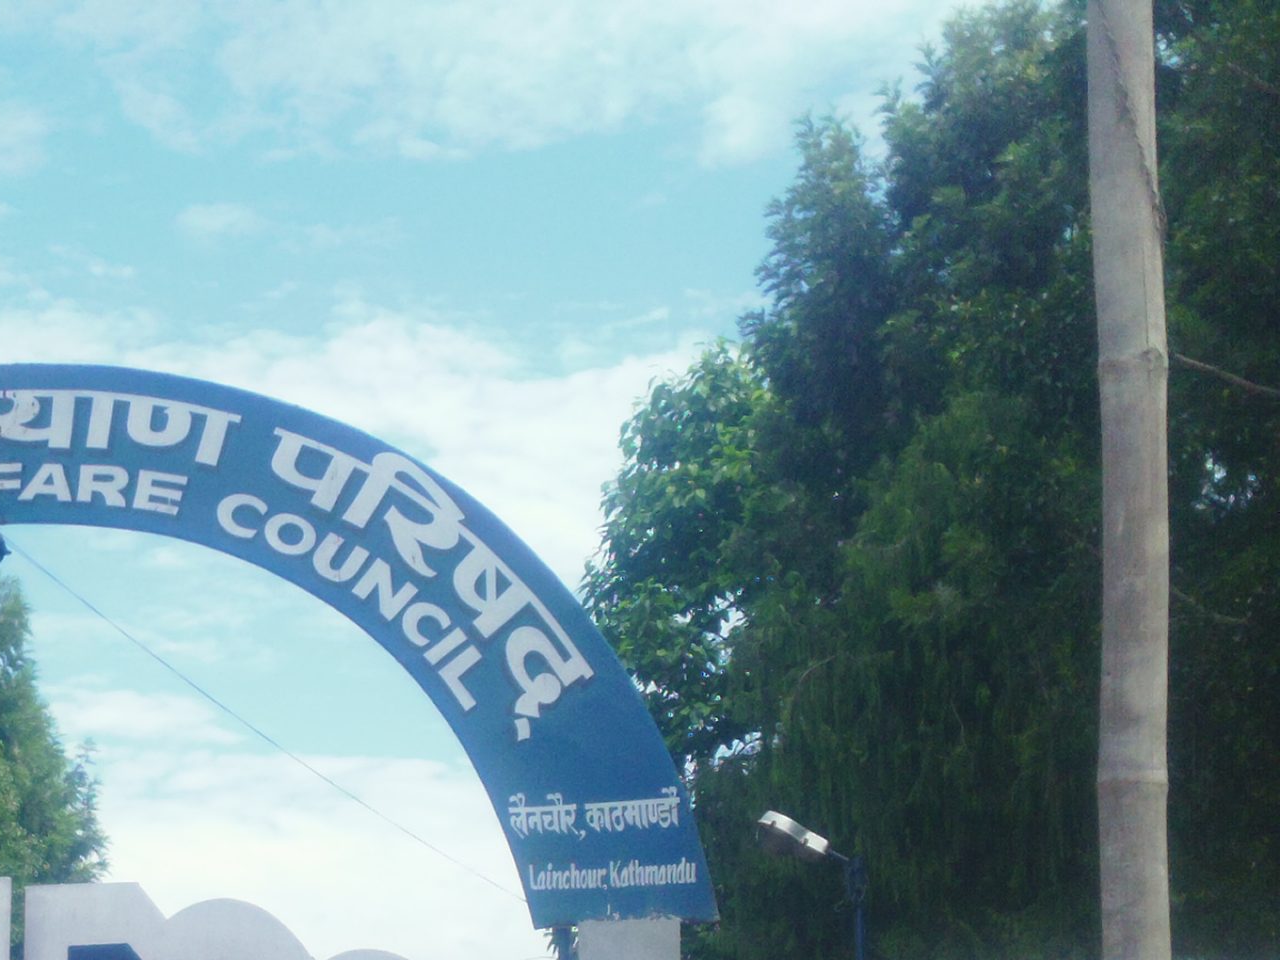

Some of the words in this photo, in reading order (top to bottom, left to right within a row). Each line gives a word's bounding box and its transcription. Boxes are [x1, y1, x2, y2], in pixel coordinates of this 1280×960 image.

[216, 493, 482, 712] COUNCIL
[271, 429, 594, 741] परिषद्
[529, 863, 607, 891] Lainchour,
[609, 857, 696, 888] Kathmandu
